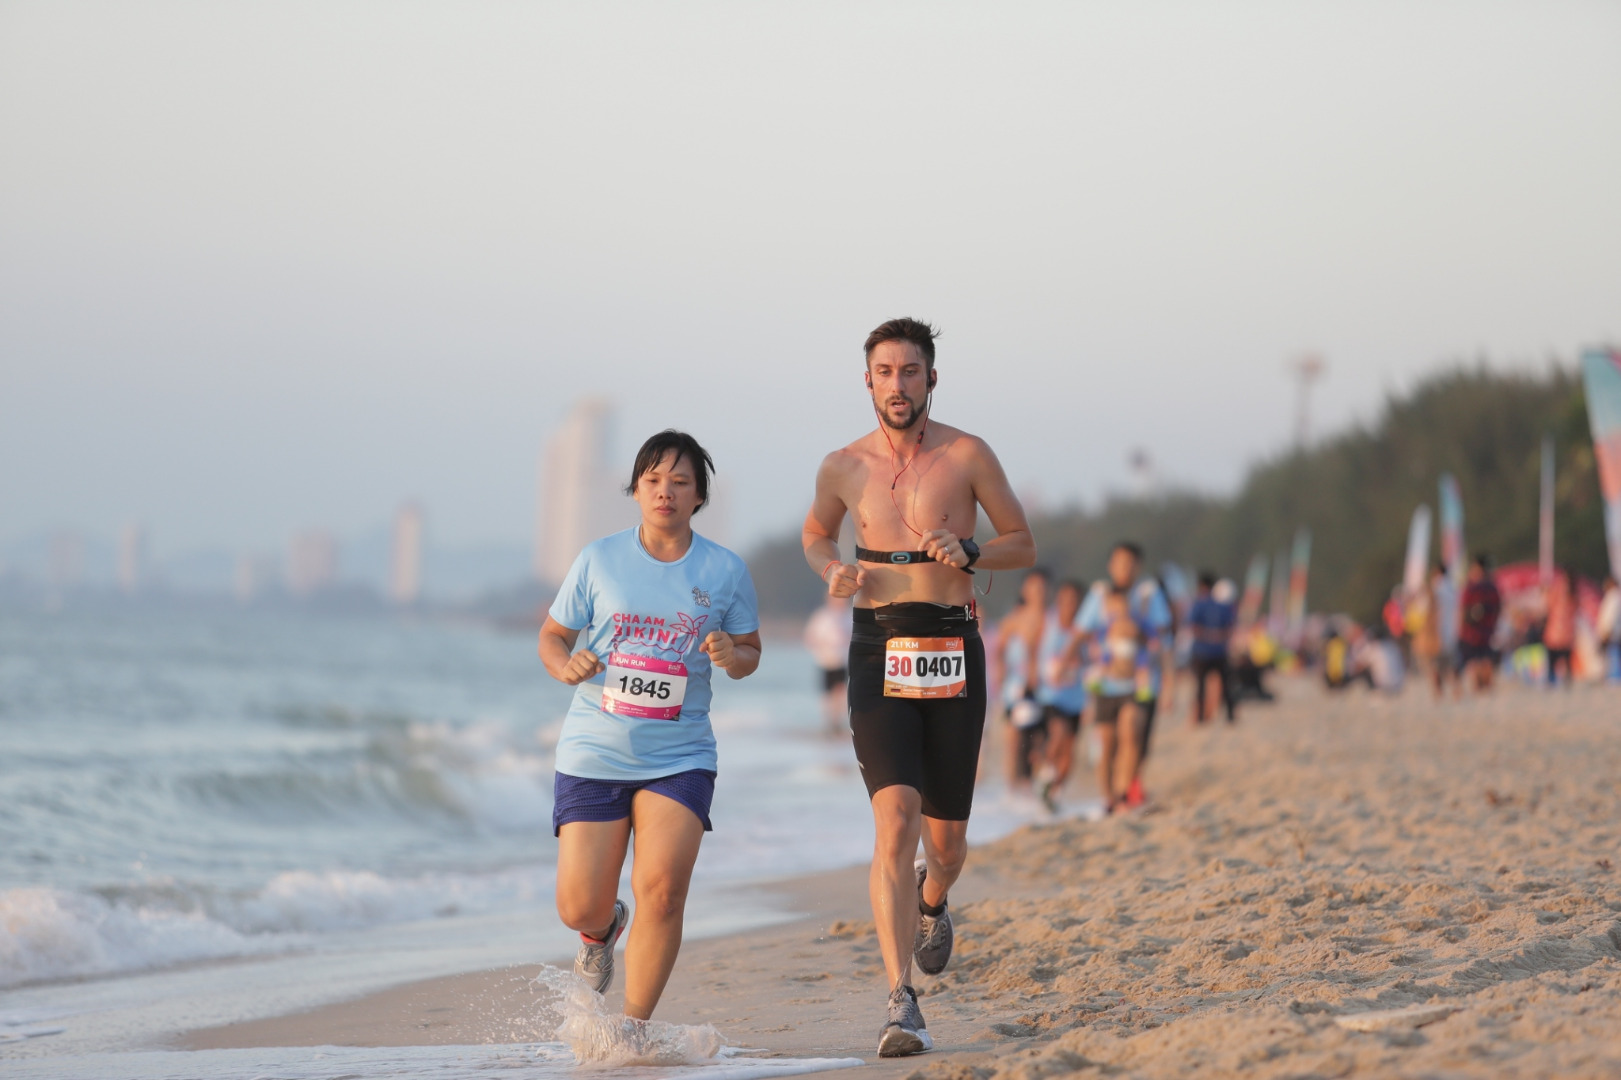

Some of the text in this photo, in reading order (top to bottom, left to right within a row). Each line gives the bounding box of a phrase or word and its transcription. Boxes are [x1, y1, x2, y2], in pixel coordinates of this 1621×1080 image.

[612, 612, 666, 627] CHA AM
[613, 625, 678, 645] BIKINI
[890, 641, 919, 649] 21.1 KM
[630, 659, 646, 667] RUN
[887, 655, 963, 678] 30 0407
[619, 675, 672, 700] 1845
